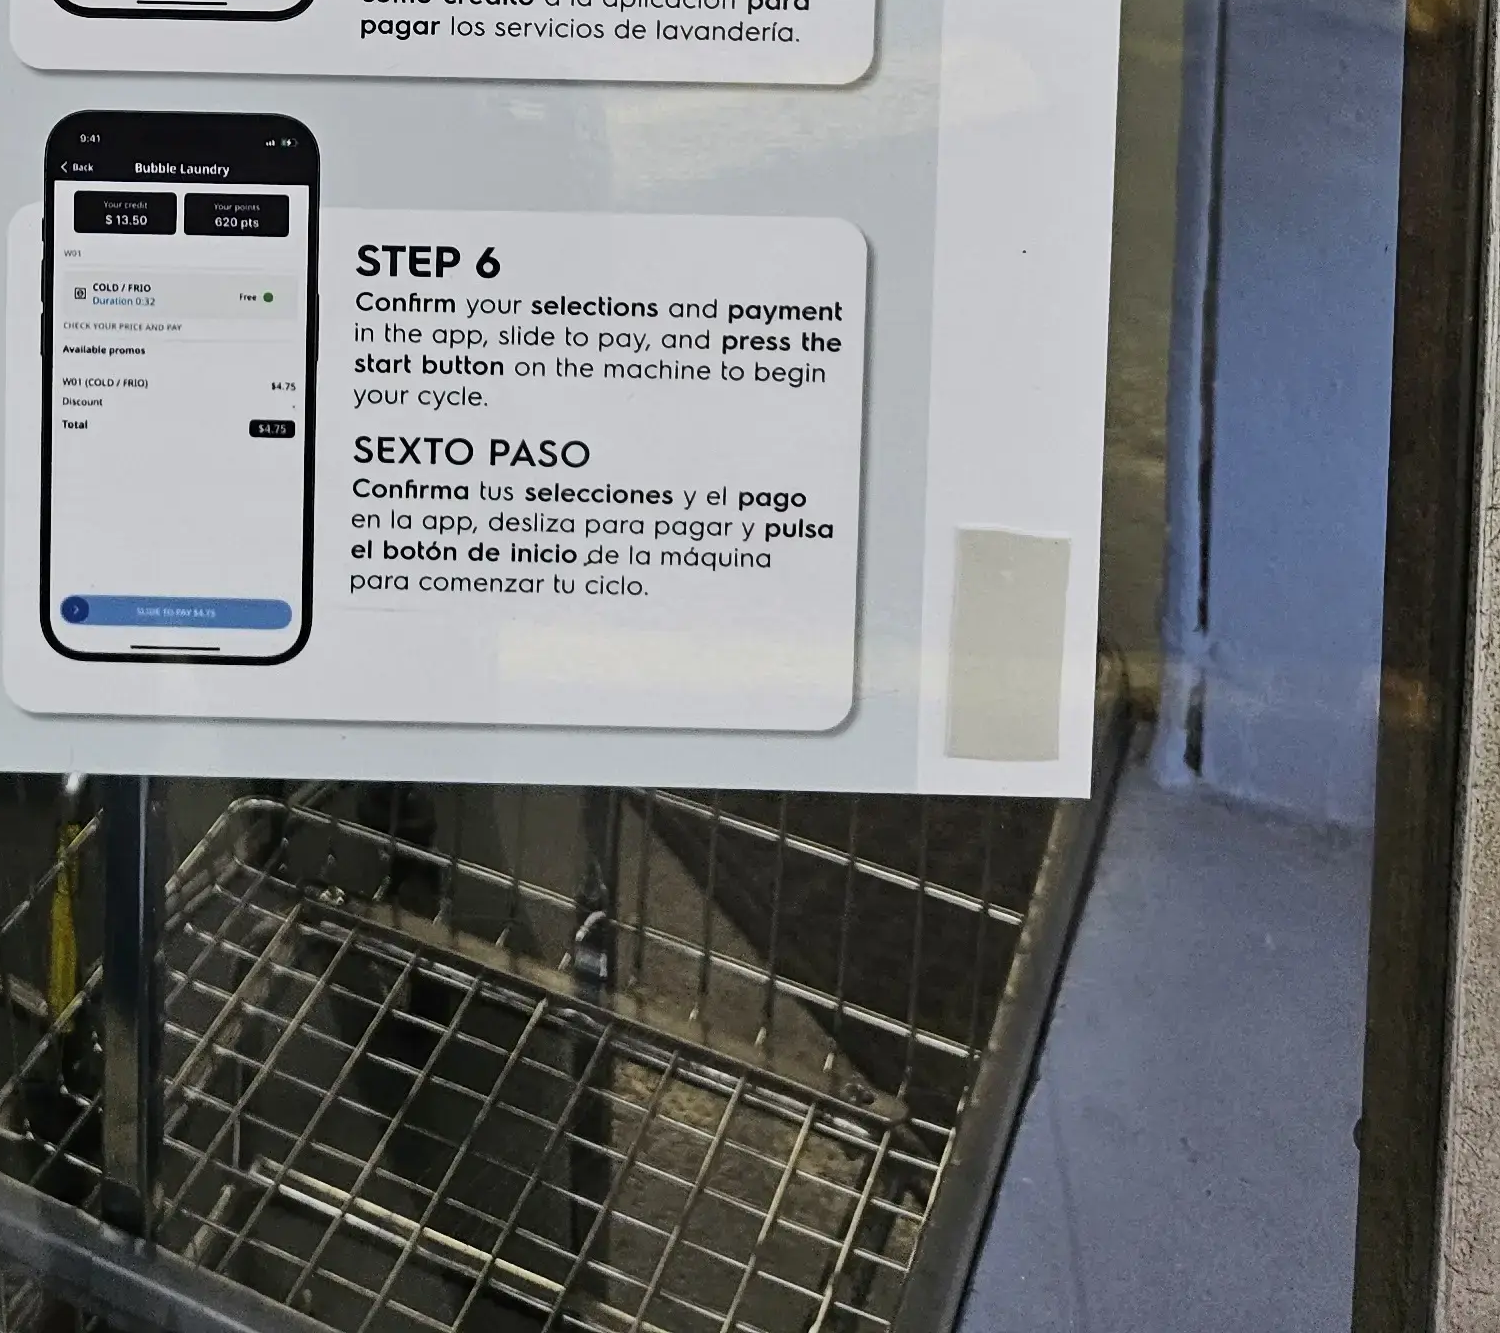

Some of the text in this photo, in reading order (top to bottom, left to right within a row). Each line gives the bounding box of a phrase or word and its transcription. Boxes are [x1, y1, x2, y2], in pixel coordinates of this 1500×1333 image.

[73, 163, 94, 172] Back
[135, 162, 230, 177] Bubble Laundry
[214, 203, 260, 213] Your points
[356, 244, 501, 279] STEP 6
[93, 283, 119, 292] COLD
[128, 284, 151, 293] FRIO
[92, 297, 155, 306] Duration 0:32
[356, 292, 842, 325] Confirm your selections and payment
[63, 345, 146, 356] Available promos
[271, 382, 296, 391] $4.75
[62, 397, 103, 406] Discount
[62, 420, 88, 429] Total
[353, 436, 590, 468] SEXTO PASO
